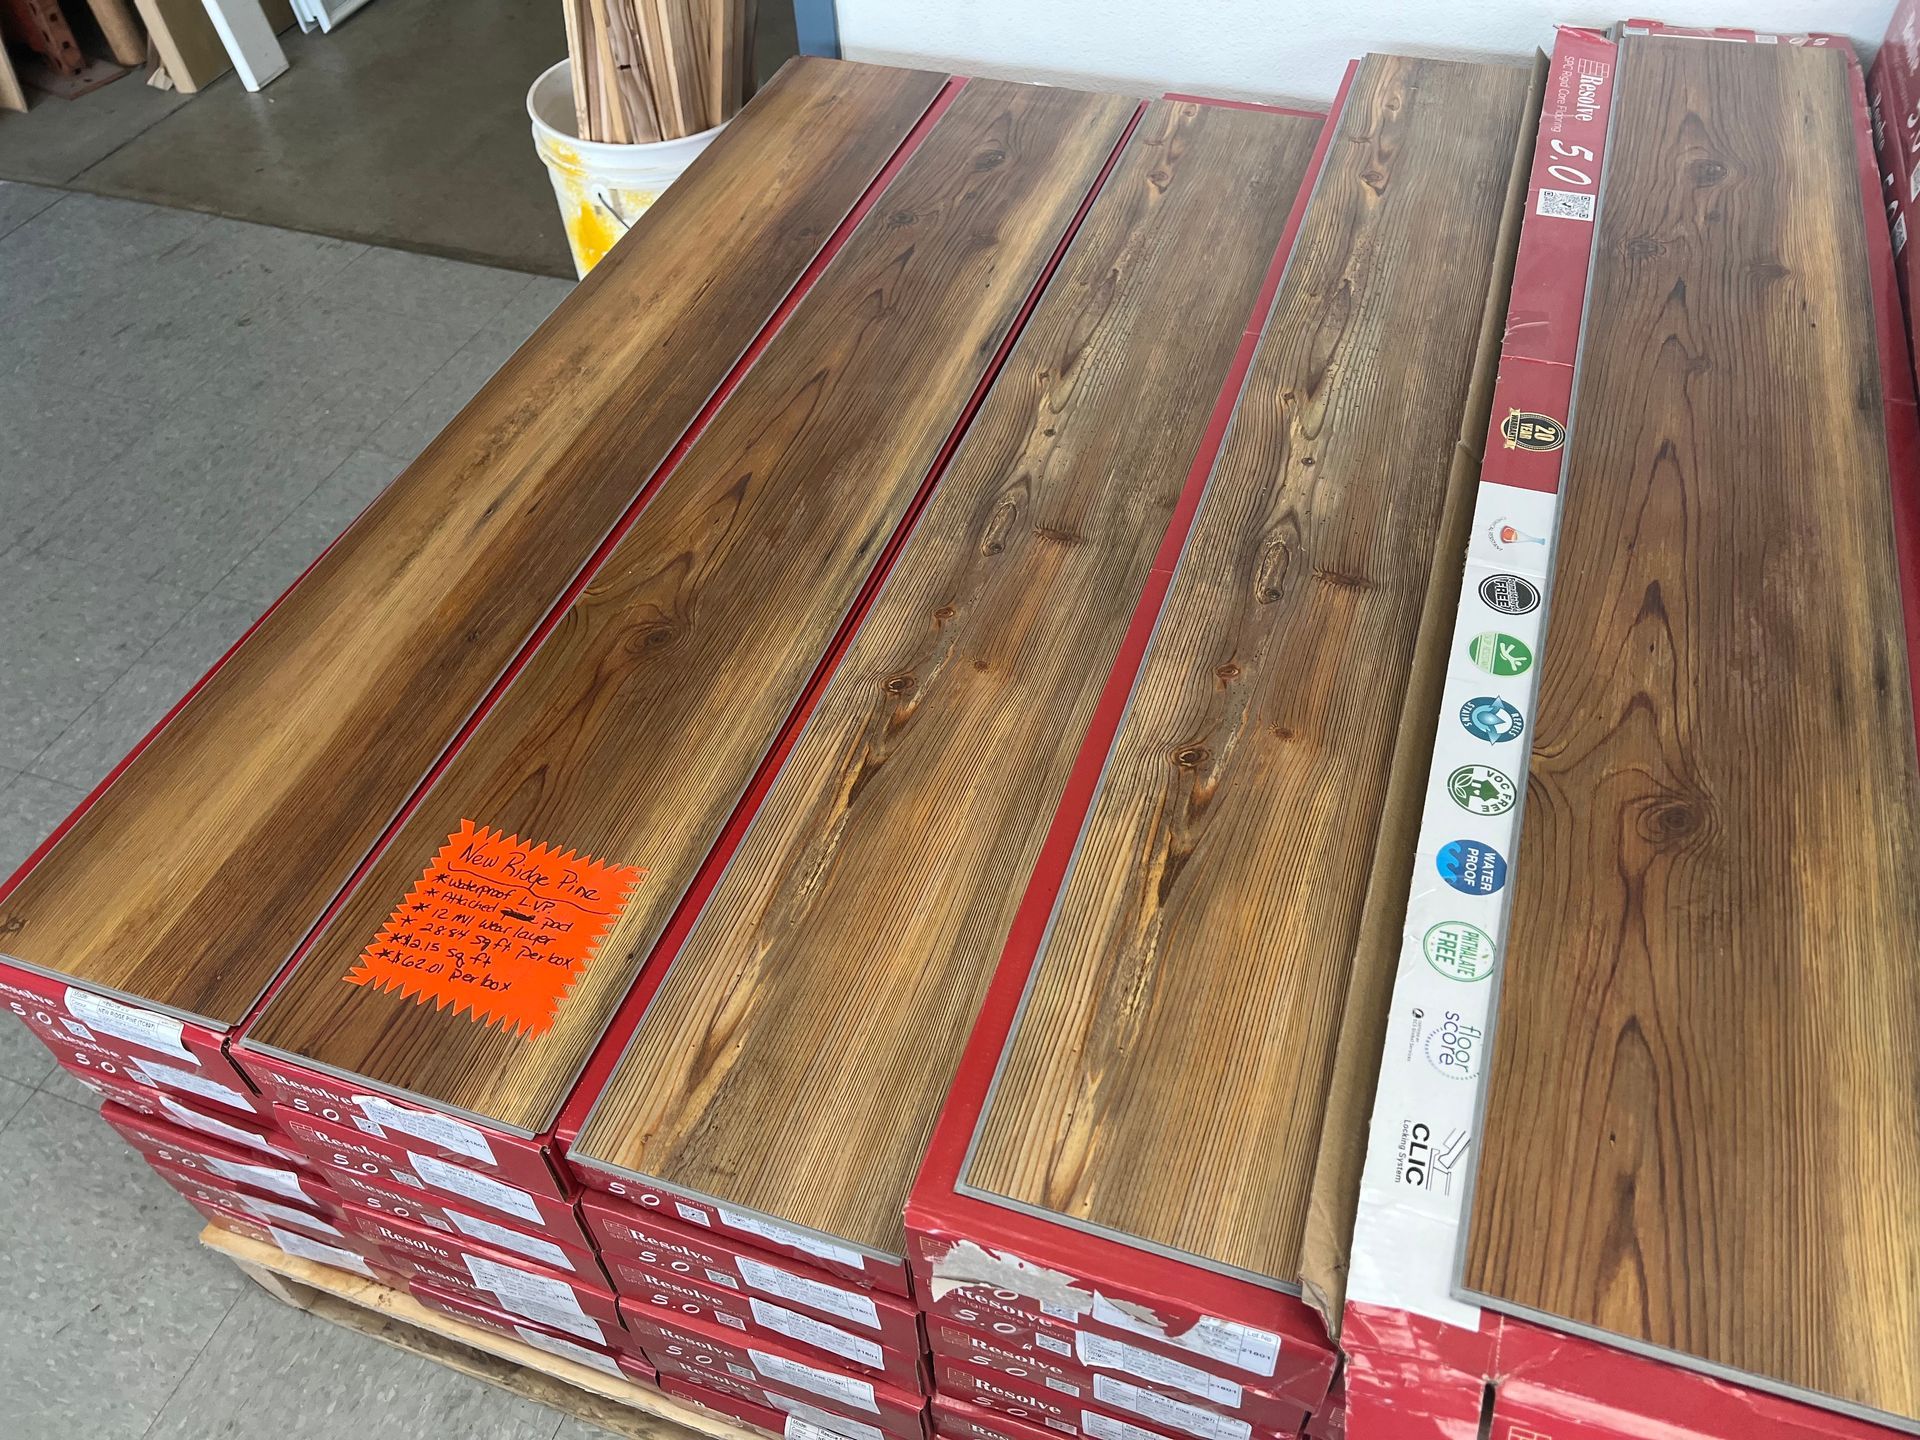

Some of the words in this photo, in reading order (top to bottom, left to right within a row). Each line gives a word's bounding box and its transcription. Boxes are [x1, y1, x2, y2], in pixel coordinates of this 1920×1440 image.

[1564, 55, 1575, 71] SPC
[1558, 71, 1573, 89] Rigid
[1555, 88, 1569, 107] Core
[1575, 74, 1603, 122] Resolve
[1551, 104, 1568, 133] Flooring
[1548, 138, 1594, 186] 5.0
[1520, 423, 1534, 440] YEAR
[1534, 424, 1556, 442] 20
[1495, 580, 1510, 609] FREE
[1460, 701, 1475, 727] STAINS
[1508, 712, 1520, 738] REPELS
[1486, 770, 1511, 791] VOC
[1481, 791, 1513, 814] FREE
[460, 842, 499, 871] New
[501, 852, 550, 889] Ridge
[557, 869, 601, 901] Pine
[1463, 847, 1479, 887] PROOF
[1479, 852, 1496, 892] WATER
[431, 908, 449, 921] 12
[512, 926, 556, 946] layer
[440, 891, 498, 915] Attached
[541, 917, 575, 933] pad
[400, 934, 441, 953] $2.15
[418, 923, 468, 941] 28.84
[546, 951, 575, 970] box
[1434, 930, 1458, 966] FREE
[1457, 930, 1480, 978] PHTHALATE
[388, 951, 445, 974] $62.01
[480, 972, 513, 992] box
[1439, 1011, 1460, 1065] score
[1455, 1025, 1482, 1073] floor
[271, 1072, 354, 1106] Resolve
[314, 1130, 393, 1163] Resolve
[1395, 1119, 1412, 1152] Locking
[1394, 1152, 1407, 1183] System
[1405, 1123, 1431, 1187] CLIC
[349, 1178, 423, 1209] Resolve
[379, 1226, 449, 1258] Resolve
[629, 1228, 714, 1264] Resolve
[643, 1274, 724, 1306] Resolve
[955, 1288, 1052, 1327] Resolve
[659, 1327, 735, 1359] Resolve
[971, 1338, 1063, 1375] Resolve
[679, 1362, 751, 1391] Resolve
[975, 1378, 1062, 1415] Resolve
